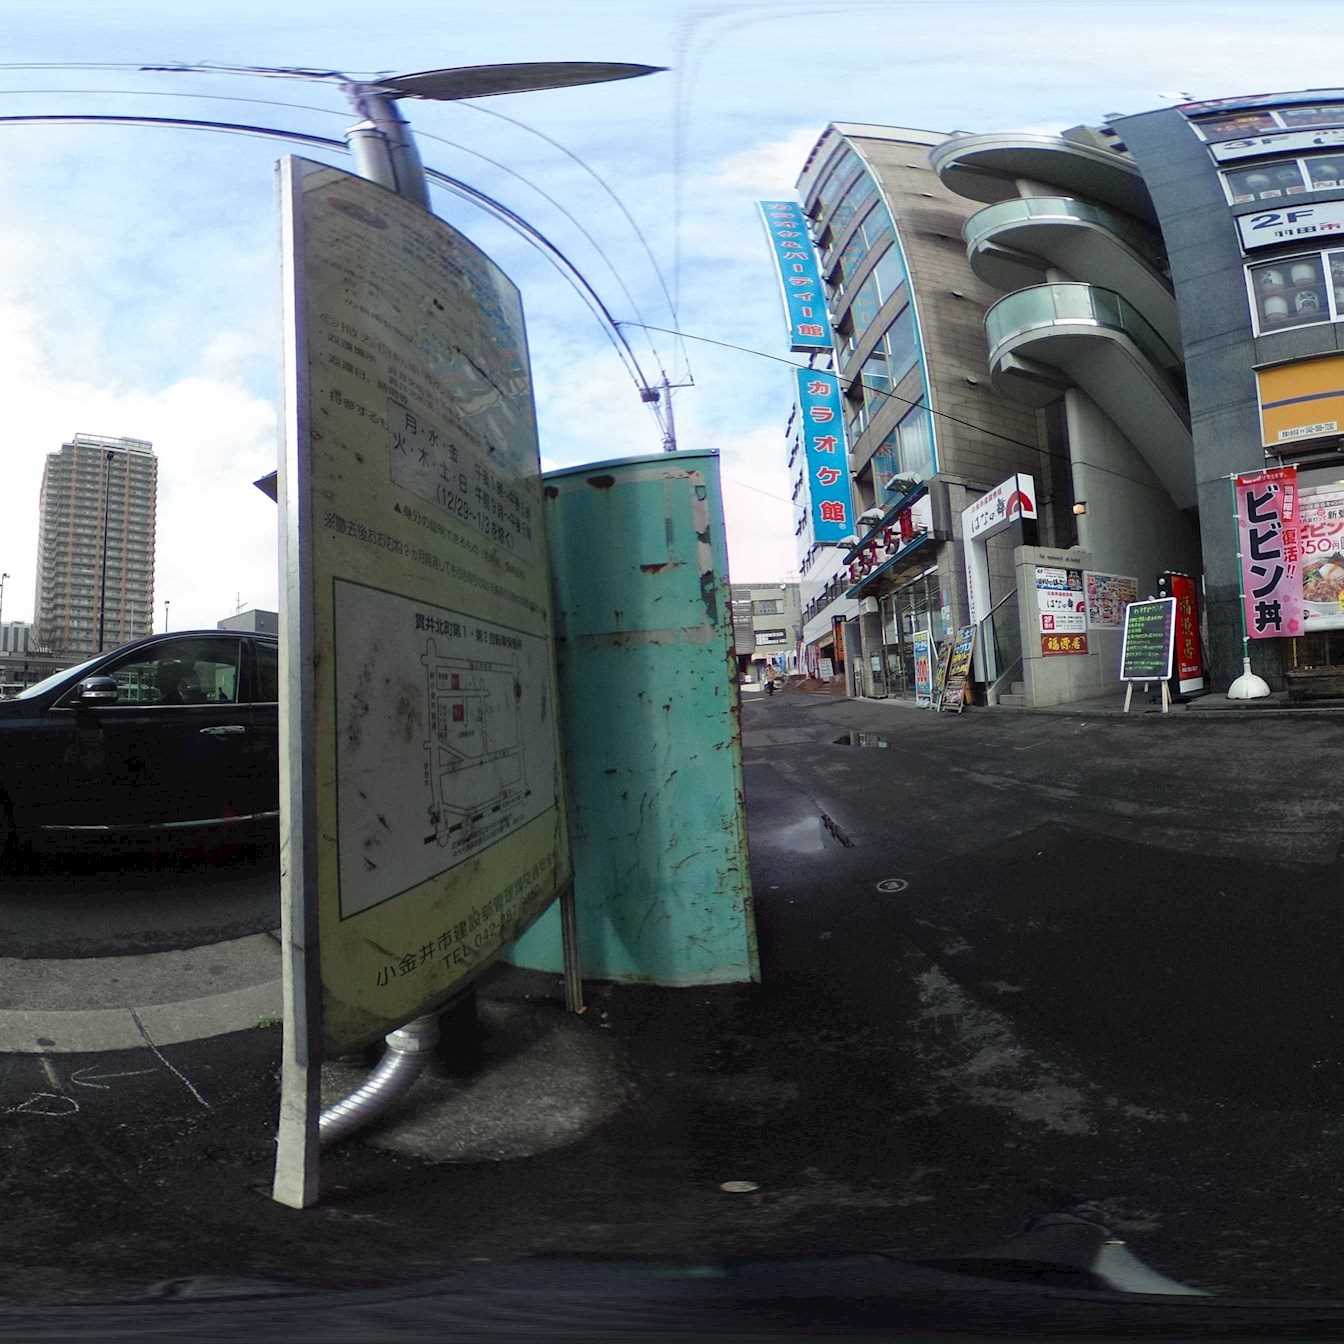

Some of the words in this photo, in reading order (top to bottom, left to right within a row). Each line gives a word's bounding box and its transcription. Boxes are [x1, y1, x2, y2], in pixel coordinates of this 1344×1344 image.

[1251, 209, 1315, 231] 2F
[808, 380, 847, 523] カラオケ館
[1246, 484, 1285, 633] ビビン丼
